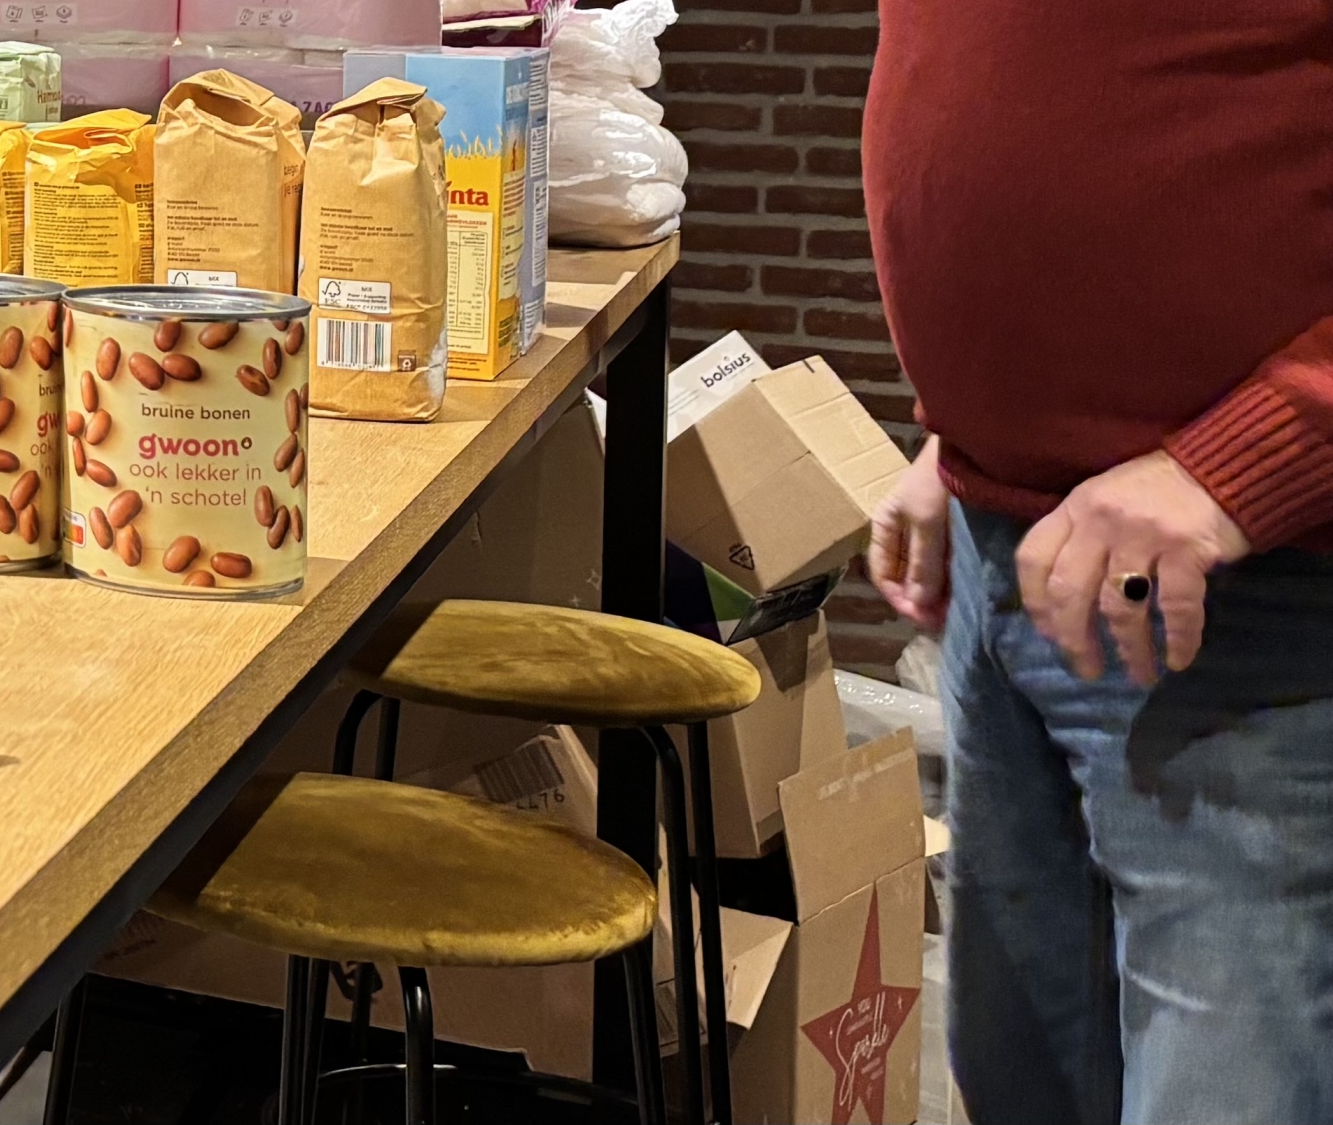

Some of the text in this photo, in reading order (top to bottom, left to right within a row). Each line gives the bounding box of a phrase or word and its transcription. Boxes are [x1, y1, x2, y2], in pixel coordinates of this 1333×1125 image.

[699, 352, 752, 389] bolsius
[141, 403, 251, 420] bruine bonen
[129, 461, 261, 481] ook lekker in
[170, 487, 246, 506] schotel
